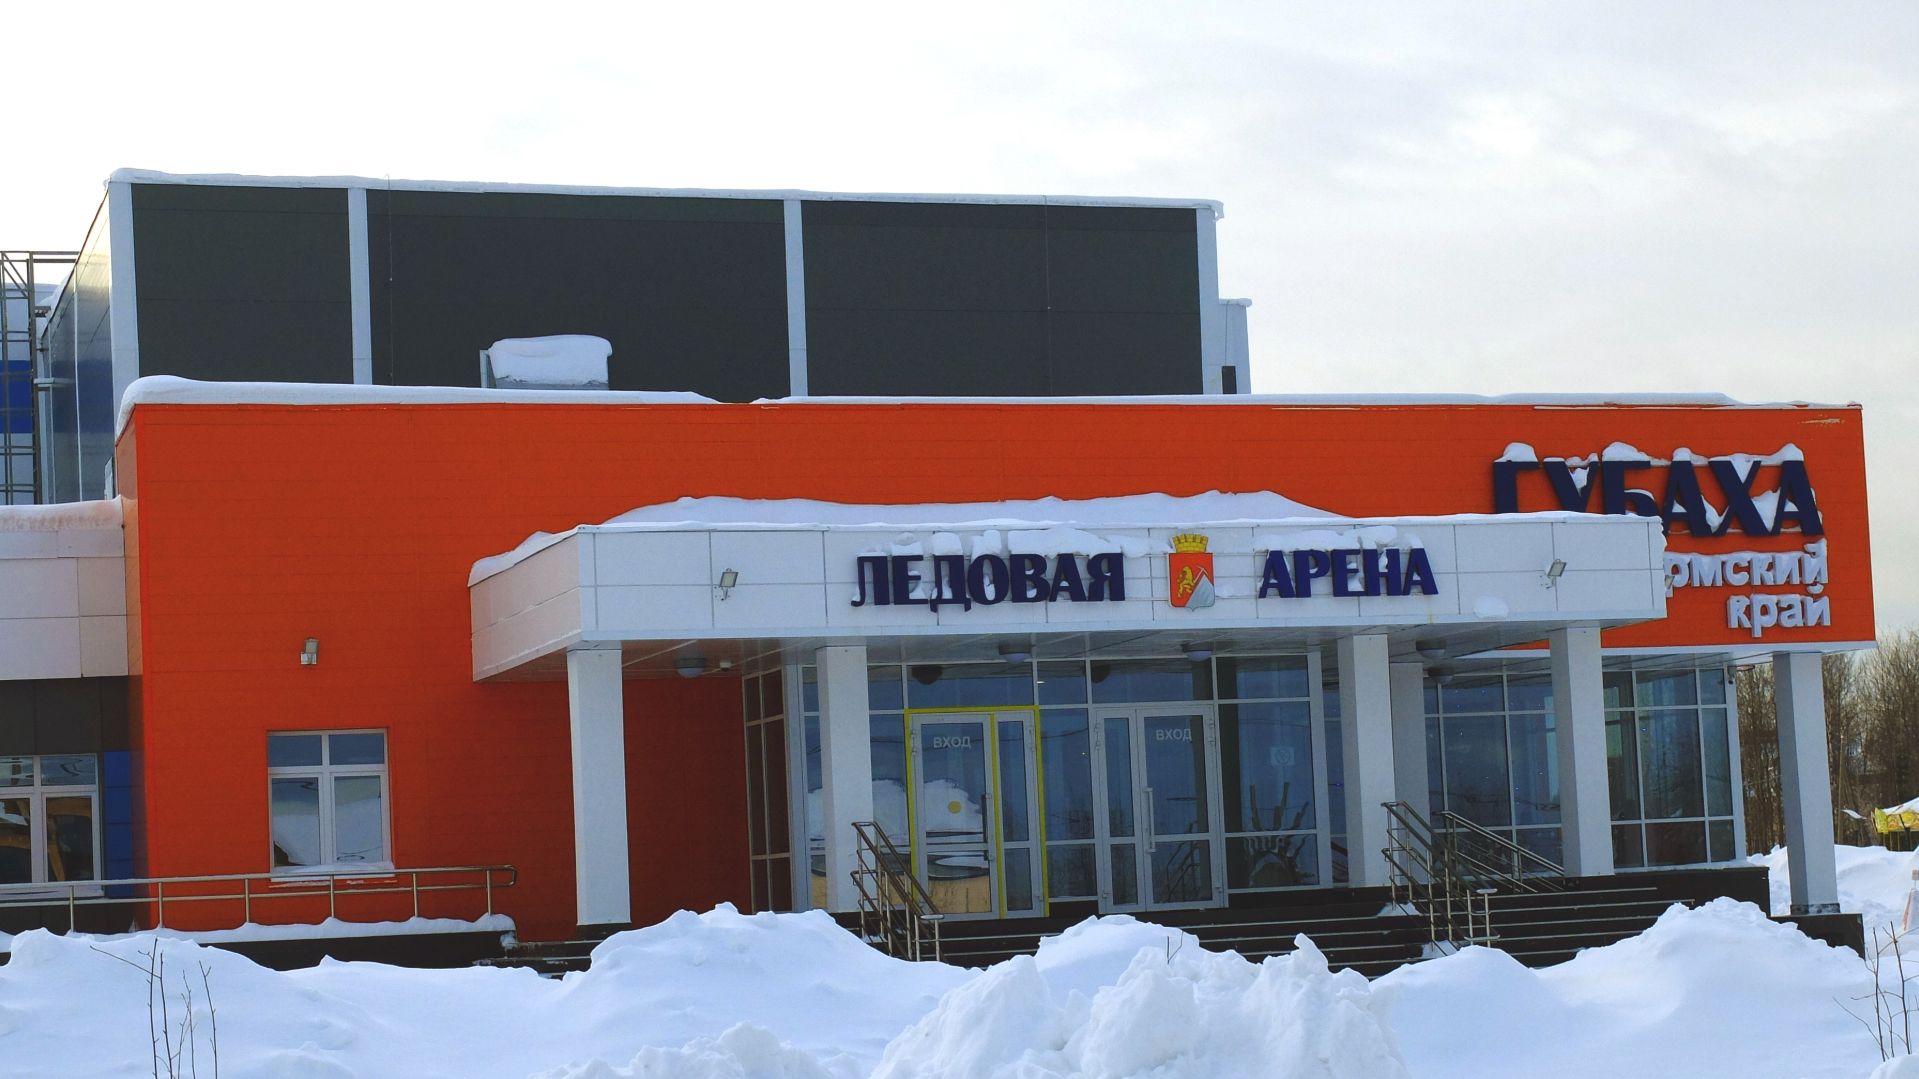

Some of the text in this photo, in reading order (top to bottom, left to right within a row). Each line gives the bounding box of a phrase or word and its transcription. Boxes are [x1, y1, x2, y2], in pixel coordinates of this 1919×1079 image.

[1493, 460, 1825, 536] ГУБАХА
[851, 548, 1439, 613] ЛЕДОВАЯ АРЕНА
[1664, 541, 1829, 598] рмский
[1727, 584, 1831, 638] край
[933, 736, 972, 749] ВХОД
[1156, 728, 1193, 741] ВХОД
